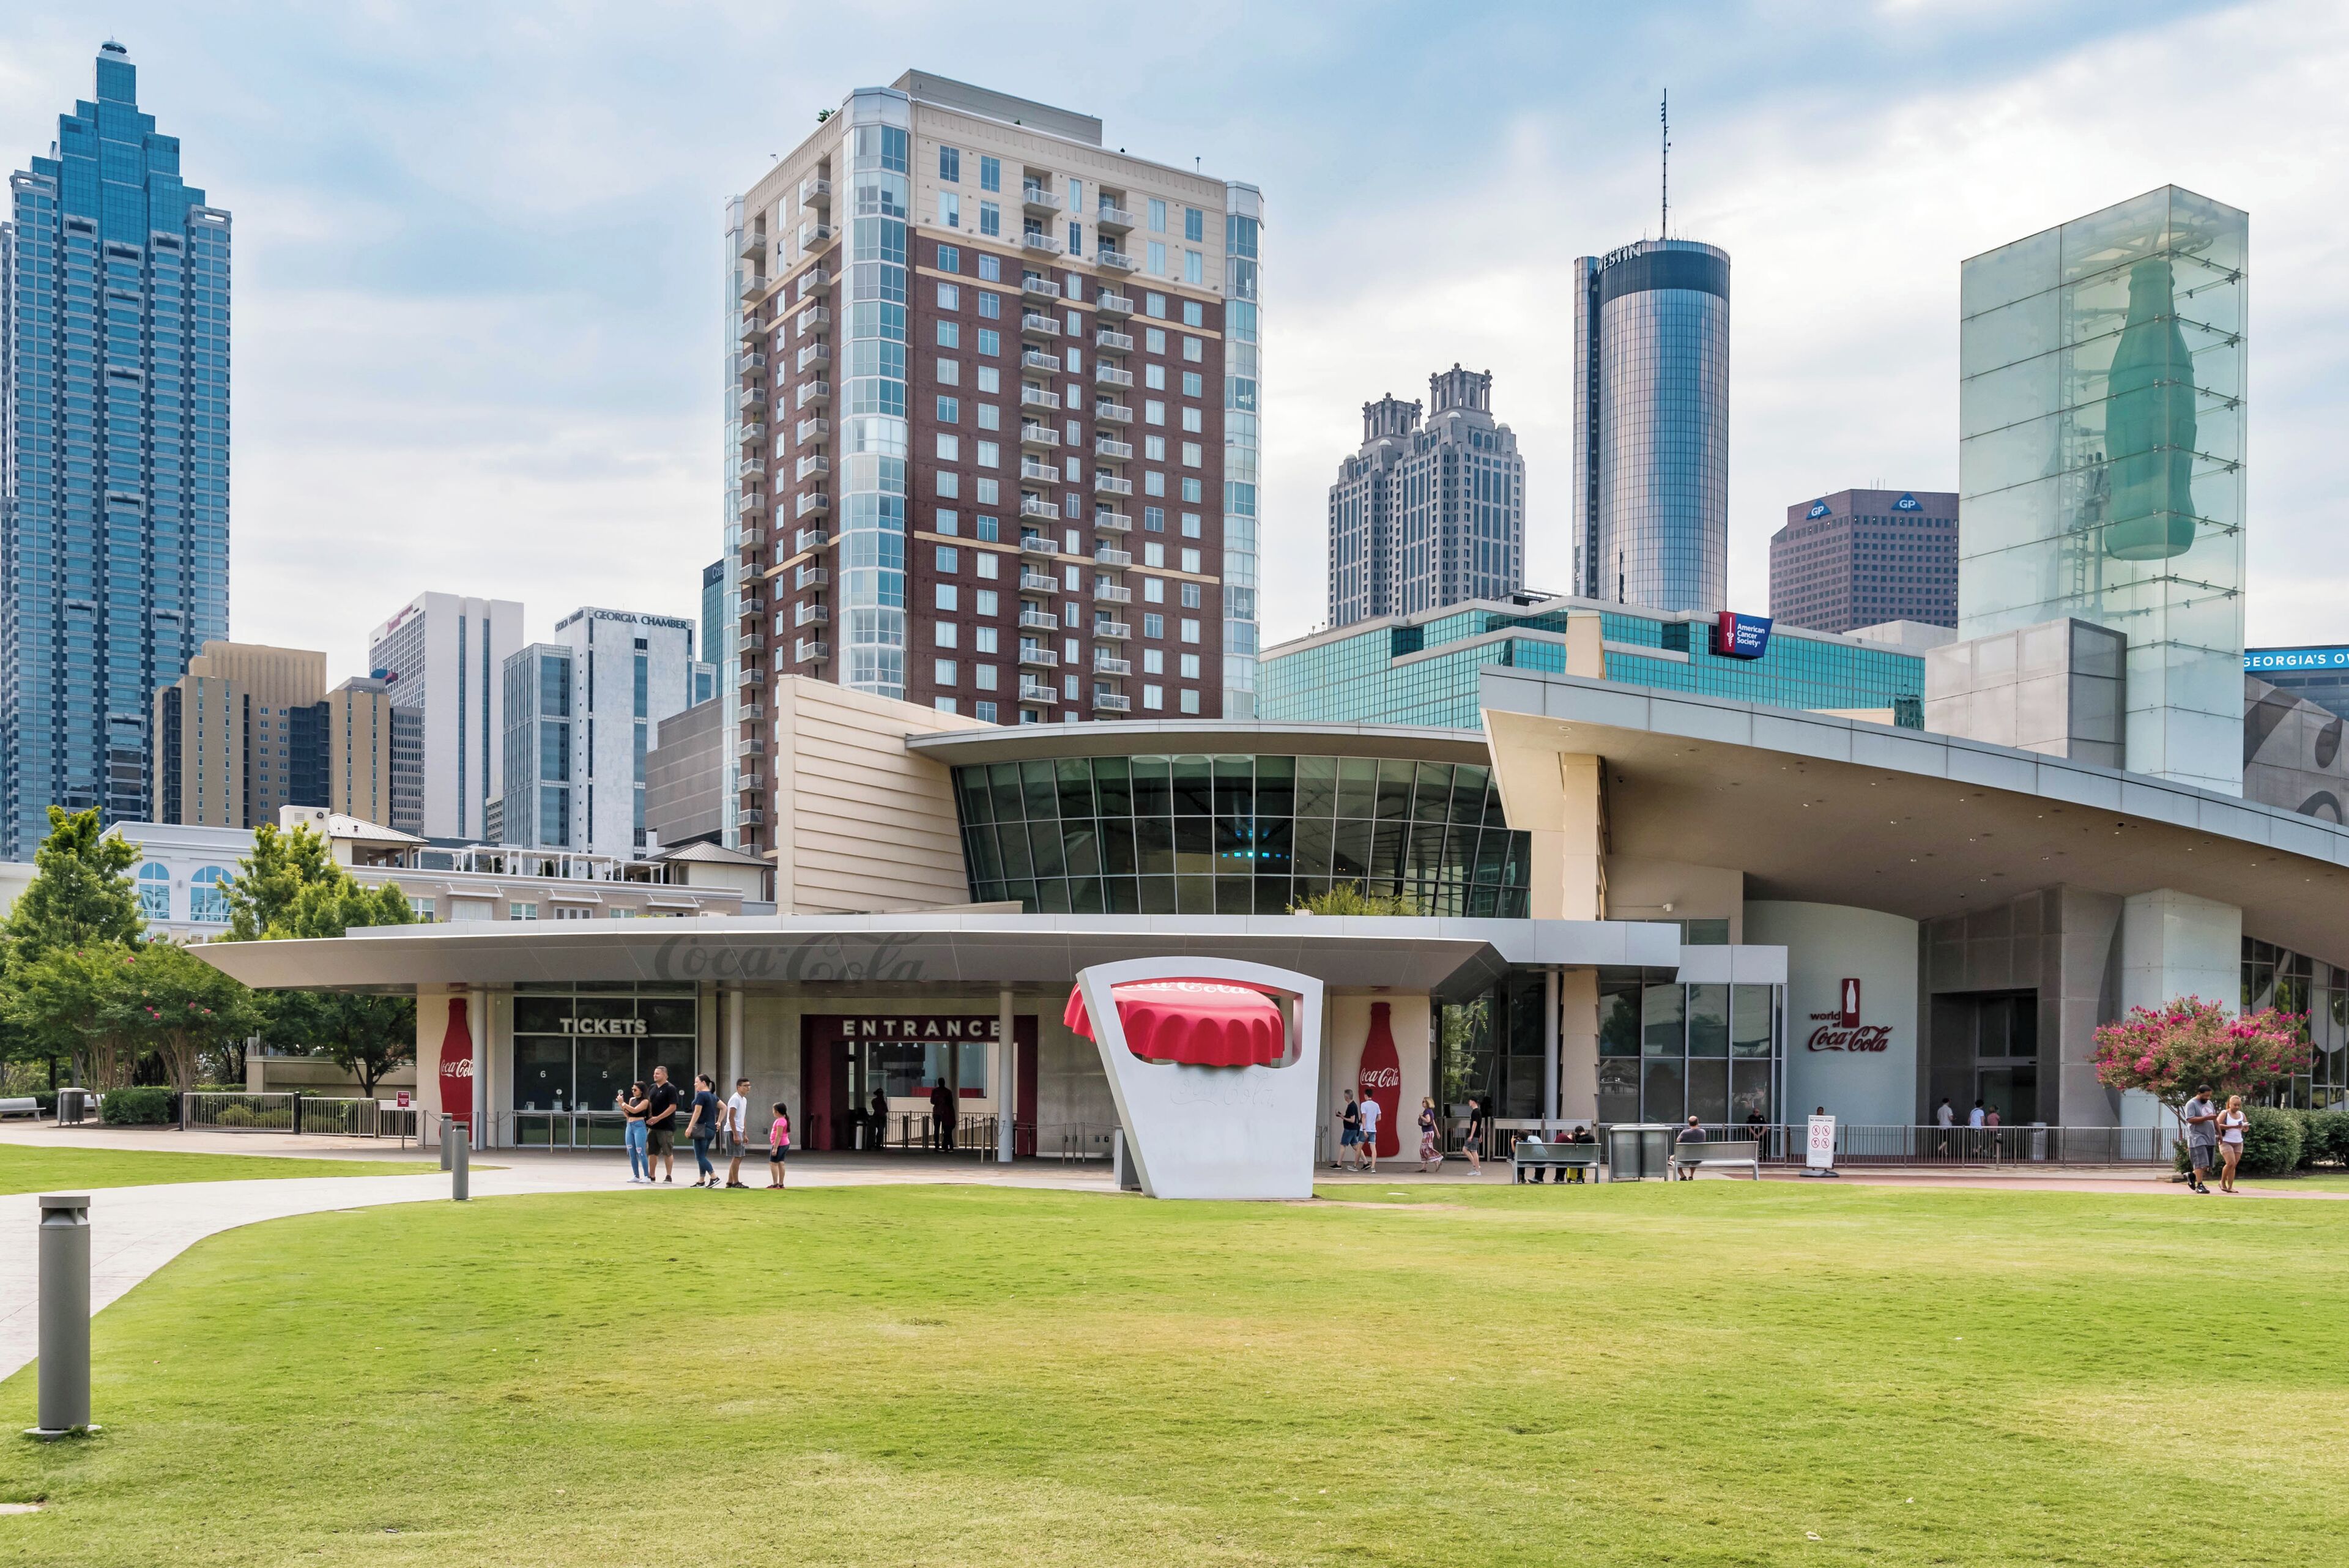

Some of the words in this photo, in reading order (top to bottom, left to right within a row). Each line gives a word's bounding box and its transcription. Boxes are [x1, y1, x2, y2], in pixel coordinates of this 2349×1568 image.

[1597, 243, 1642, 275] WESTIN
[1811, 505, 1824, 516] GP
[1899, 499, 1916, 508] GP
[594, 610, 637, 623] GEORGIA
[641, 615, 687, 630] CHAMBER
[1737, 623, 1765, 634] American
[1737, 630, 1757, 639] Cancer
[2244, 654, 2326, 667] GEORGIA'S
[2334, 653, 2349, 664] O
[655, 932, 930, 980] Coca-Cola
[1811, 1011, 1841, 1020] world
[560, 1018, 647, 1034] TICKETS
[843, 1020, 1000, 1037] ENTRANCE
[1809, 1025, 1893, 1052] Coca-Cola
[1360, 1067, 1399, 1088] Coca-Cola
